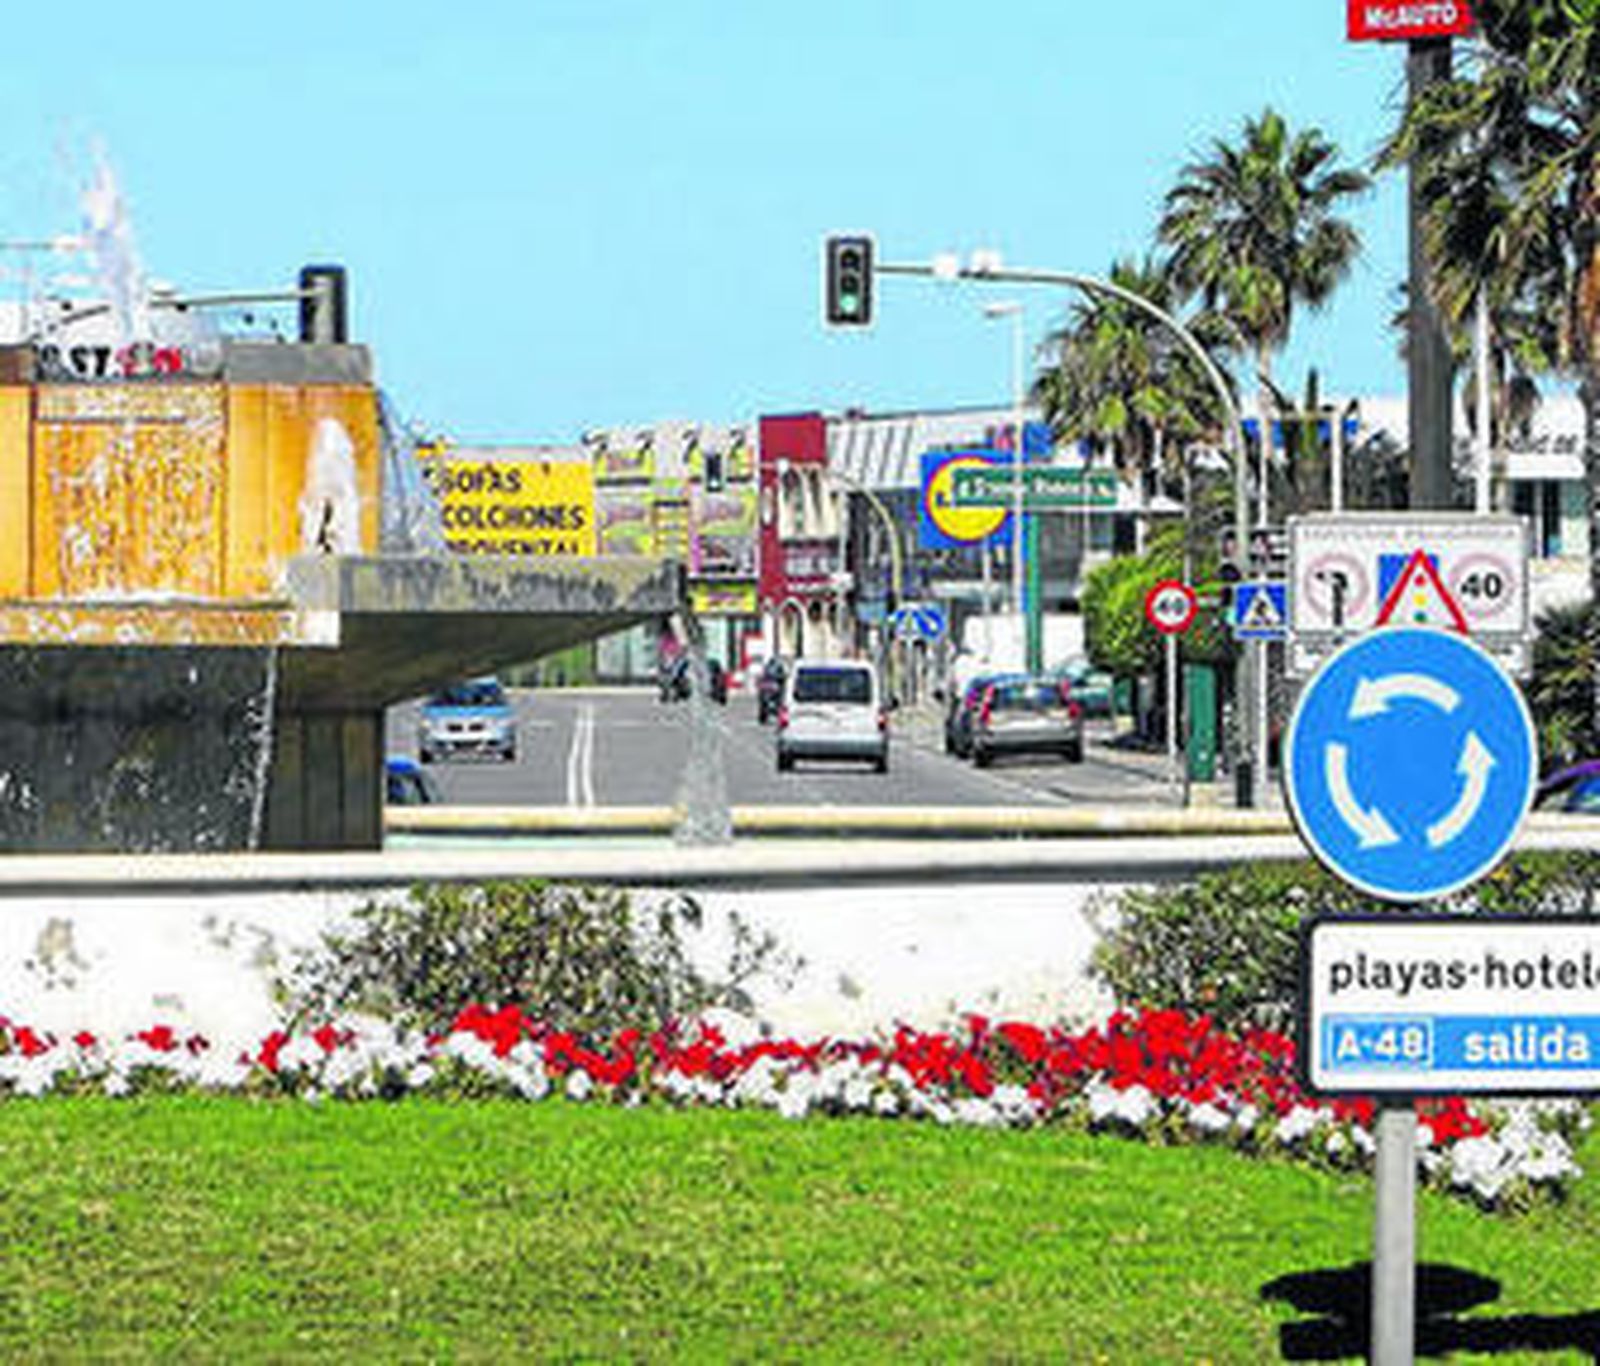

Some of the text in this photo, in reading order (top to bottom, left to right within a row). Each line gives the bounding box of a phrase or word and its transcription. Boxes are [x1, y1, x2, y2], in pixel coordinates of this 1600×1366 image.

[441, 504, 586, 530] COLCHONES
[1460, 572, 1502, 599] 40
[1155, 596, 1185, 617] 40
[1463, 1023, 1592, 1064] salida
